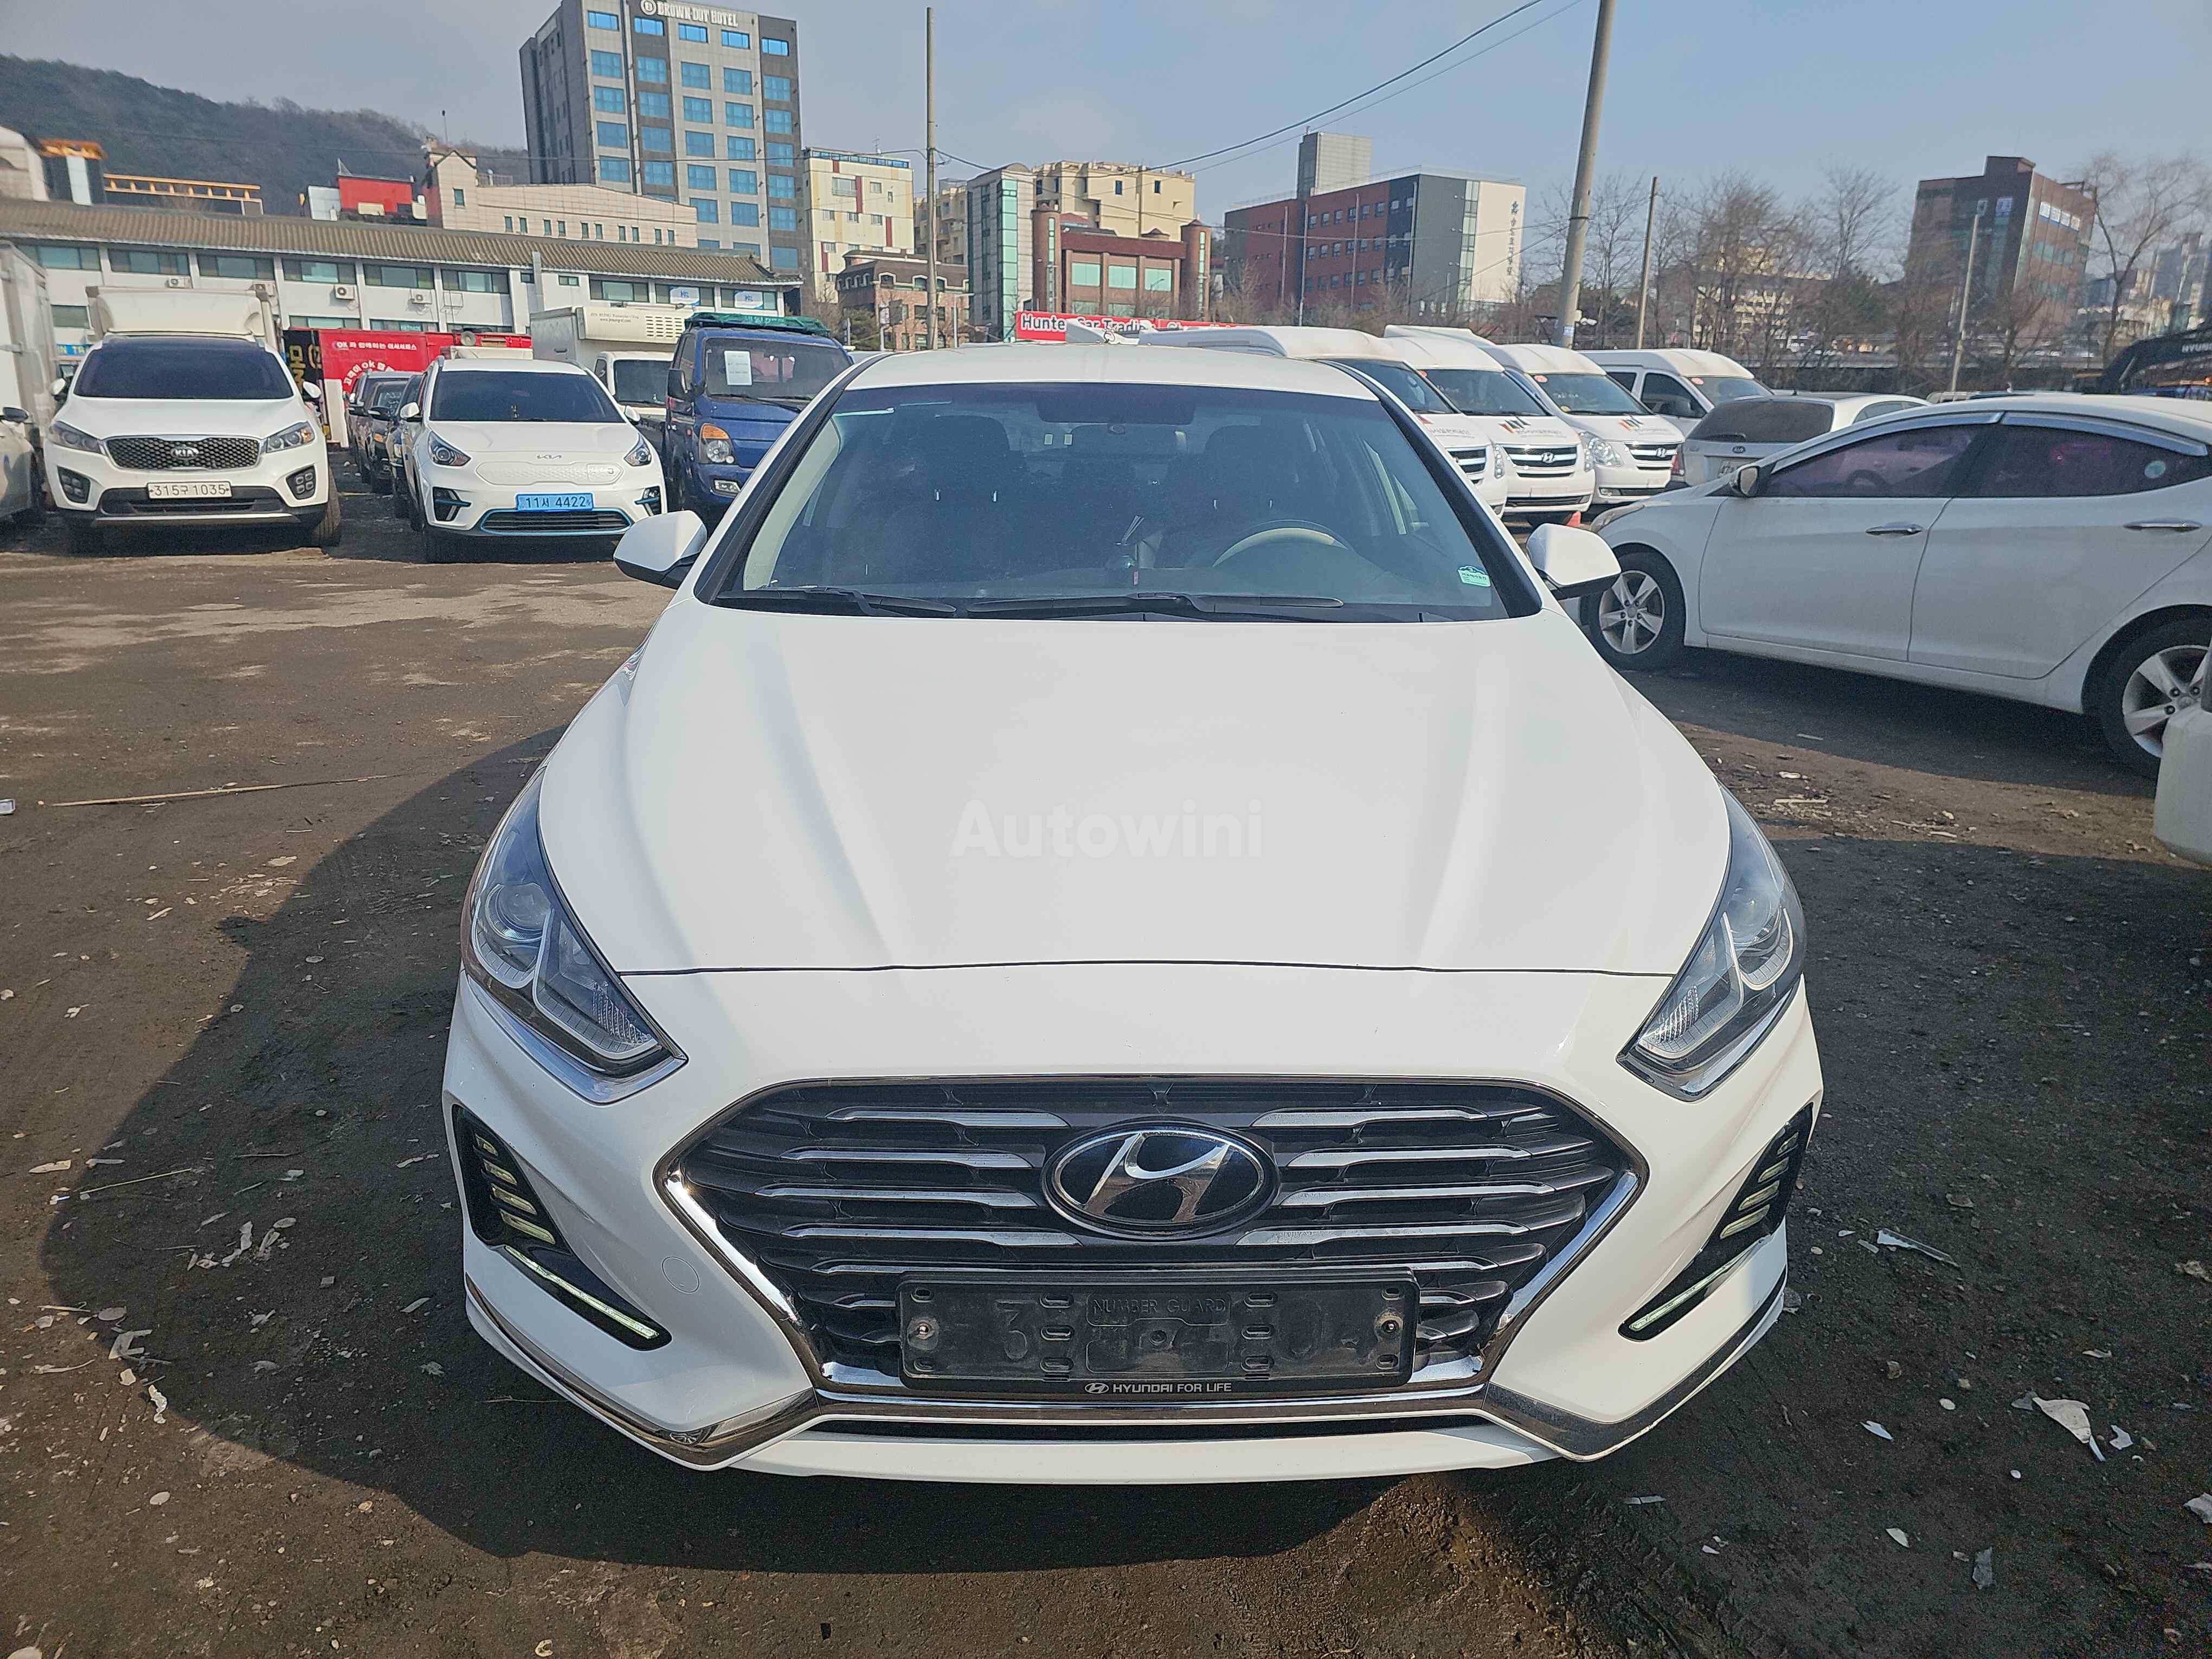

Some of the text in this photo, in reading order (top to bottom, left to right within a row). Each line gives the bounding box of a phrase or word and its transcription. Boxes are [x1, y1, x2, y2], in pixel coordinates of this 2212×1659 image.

[710, 9, 738, 27] HOTEL
[1023, 314, 1066, 330] Hunte
[172, 447, 199, 458] KIA
[193, 484, 226, 495] 1035
[555, 496, 586, 507] 4422
[1093, 1298, 1226, 1314] NUMBER GUARD
[1113, 1382, 1232, 1393] HYUNDAI FOR LIFE
